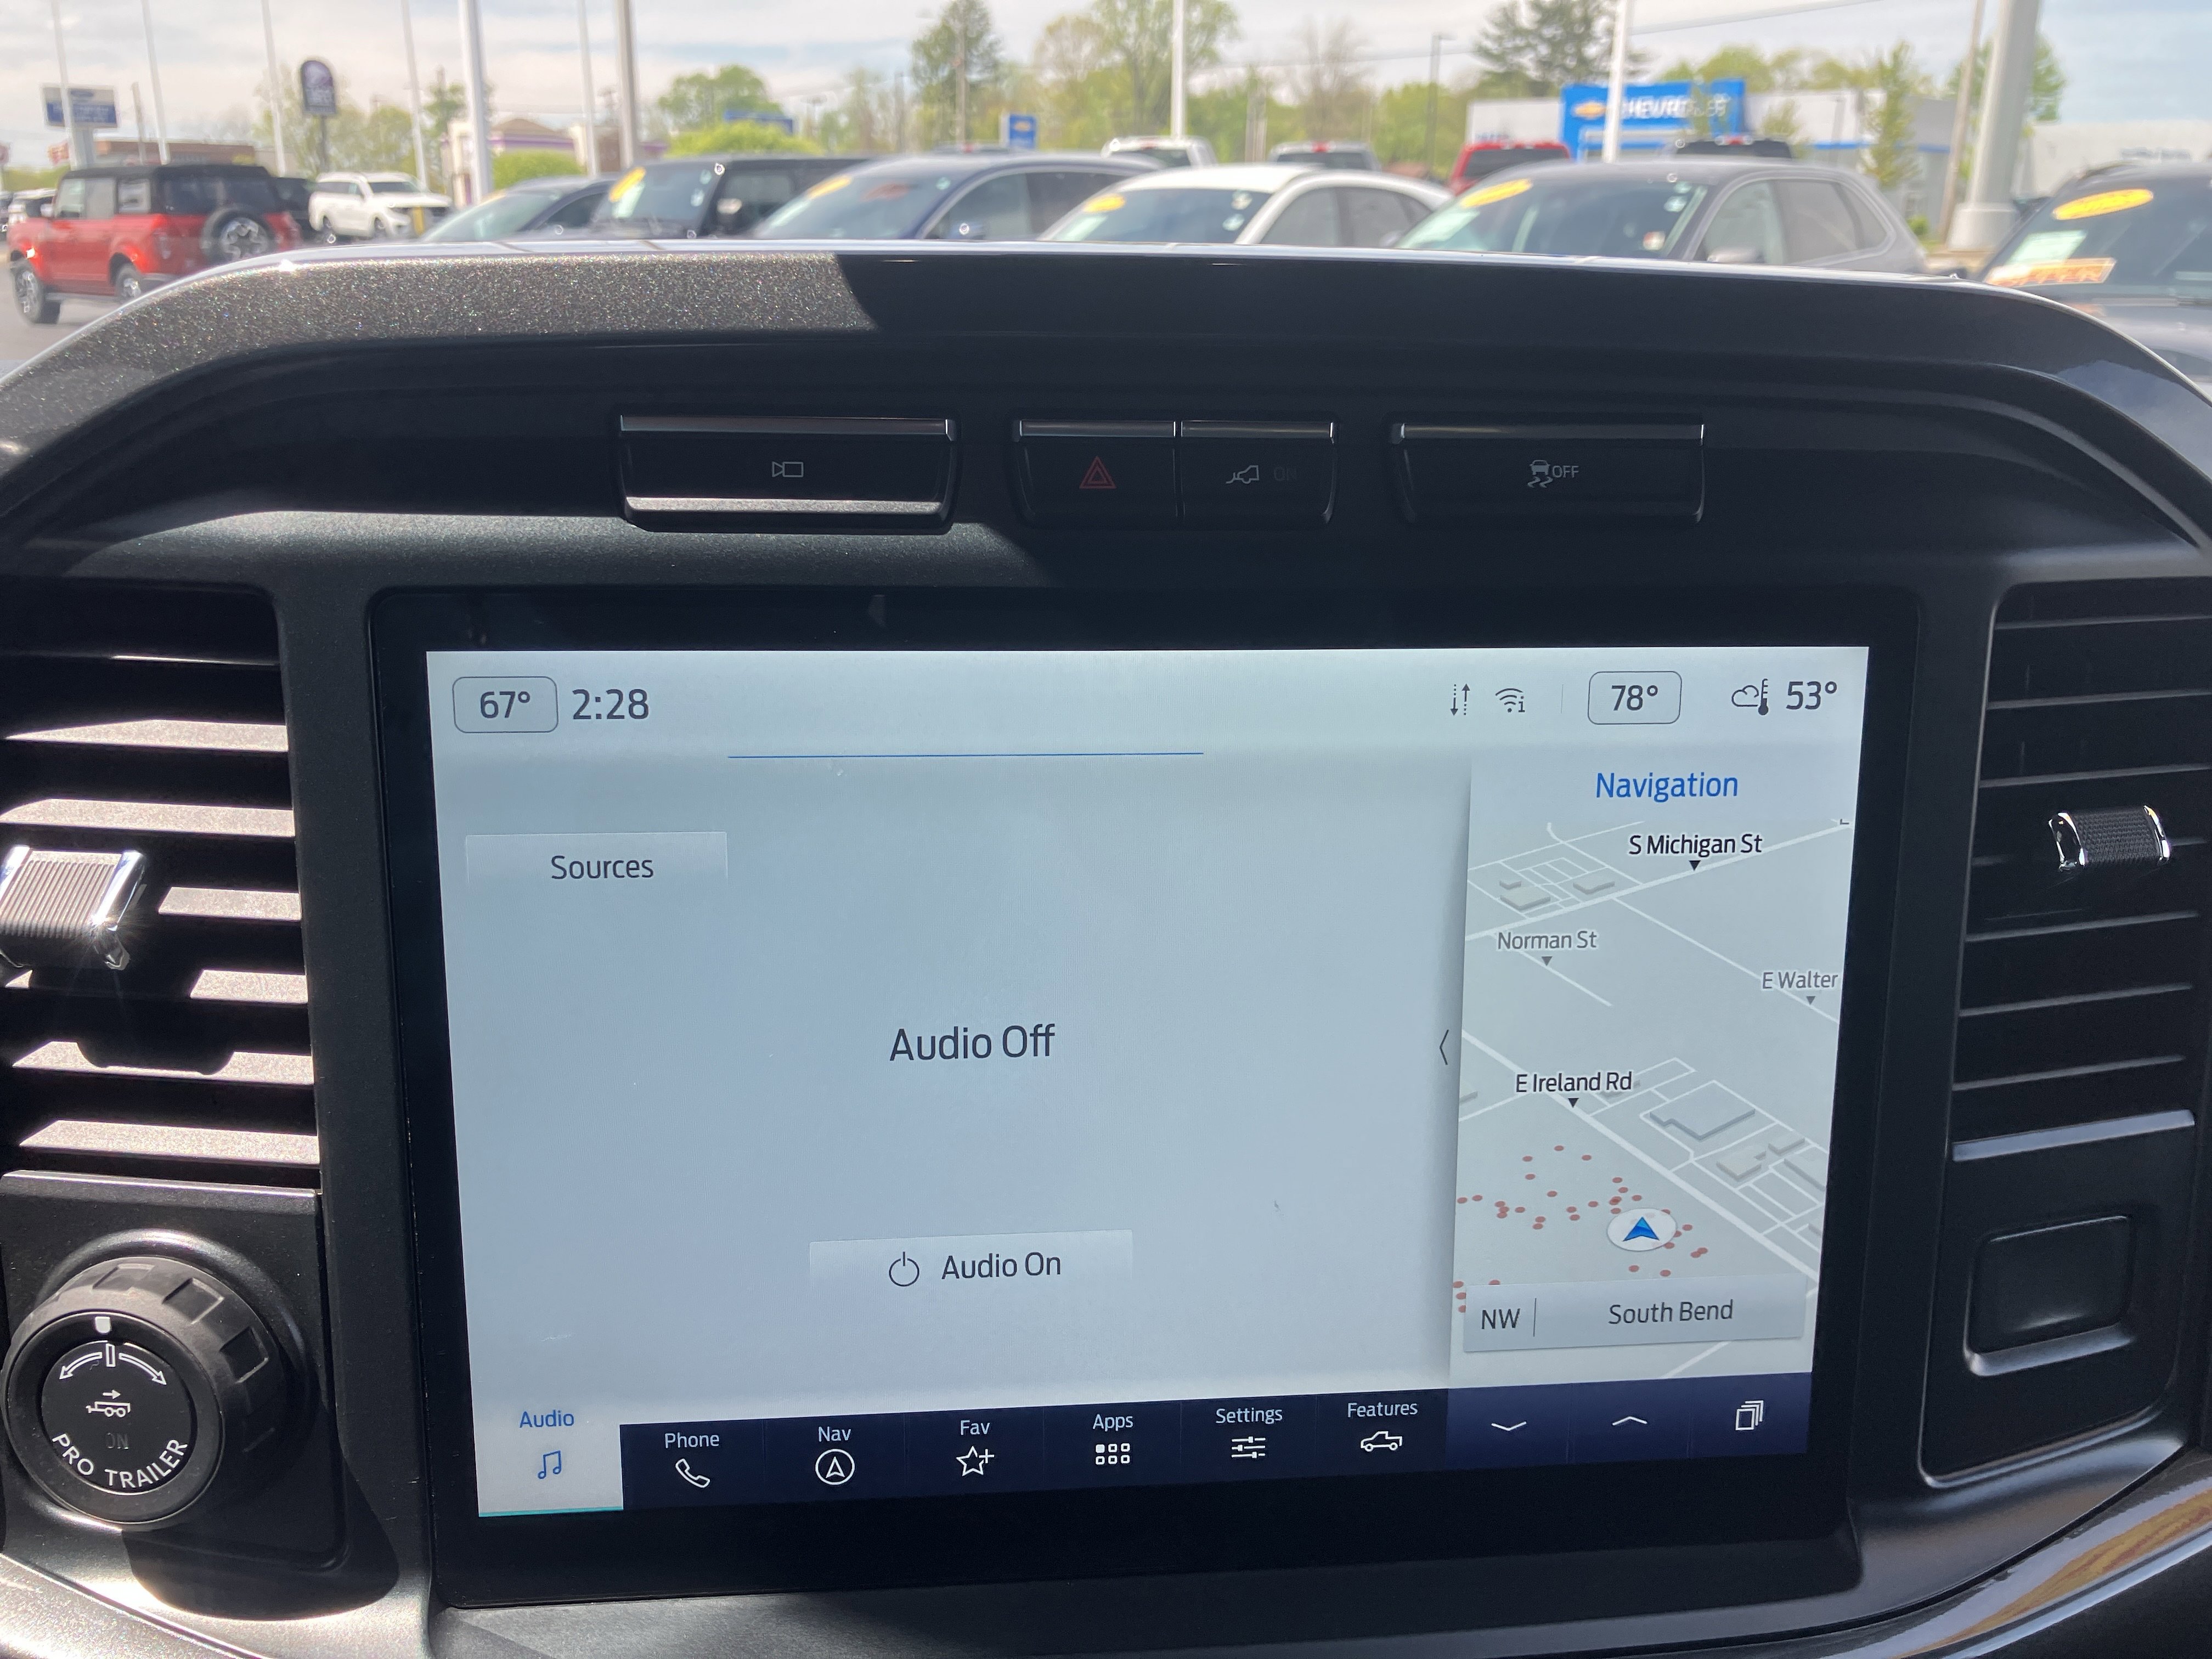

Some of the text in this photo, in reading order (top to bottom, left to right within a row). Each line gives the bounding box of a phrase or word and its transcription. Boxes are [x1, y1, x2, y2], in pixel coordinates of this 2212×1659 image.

[1618, 92, 1731, 120] HEVRET
[1552, 465, 1579, 478] OFF
[480, 691, 531, 719] 67°
[572, 689, 649, 720] 2:28
[1611, 685, 1658, 711] 78°
[1786, 681, 1837, 710] 53°
[1596, 771, 1738, 803] Navigation
[1629, 833, 1763, 858] S Michigan St
[551, 855, 654, 879] Sources
[1498, 930, 1597, 950] Norman St
[1762, 970, 1838, 989] E Walter
[889, 1023, 1056, 1062] Audio Off
[1516, 1071, 1632, 1093] E Ireland Rd
[941, 1252, 1061, 1280] Audio On
[1481, 1308, 1520, 1330] NW
[1609, 1299, 1733, 1324] South Bend
[520, 1409, 574, 1428] Audio
[1216, 1408, 1283, 1425] Settings
[1347, 1402, 1418, 1418] Features
[818, 1426, 851, 1442] Nav
[960, 1420, 990, 1435] Fav
[1092, 1414, 1133, 1432] Apps
[664, 1432, 720, 1448] Phone
[52, 1433, 188, 1488] PRO TRAILER
